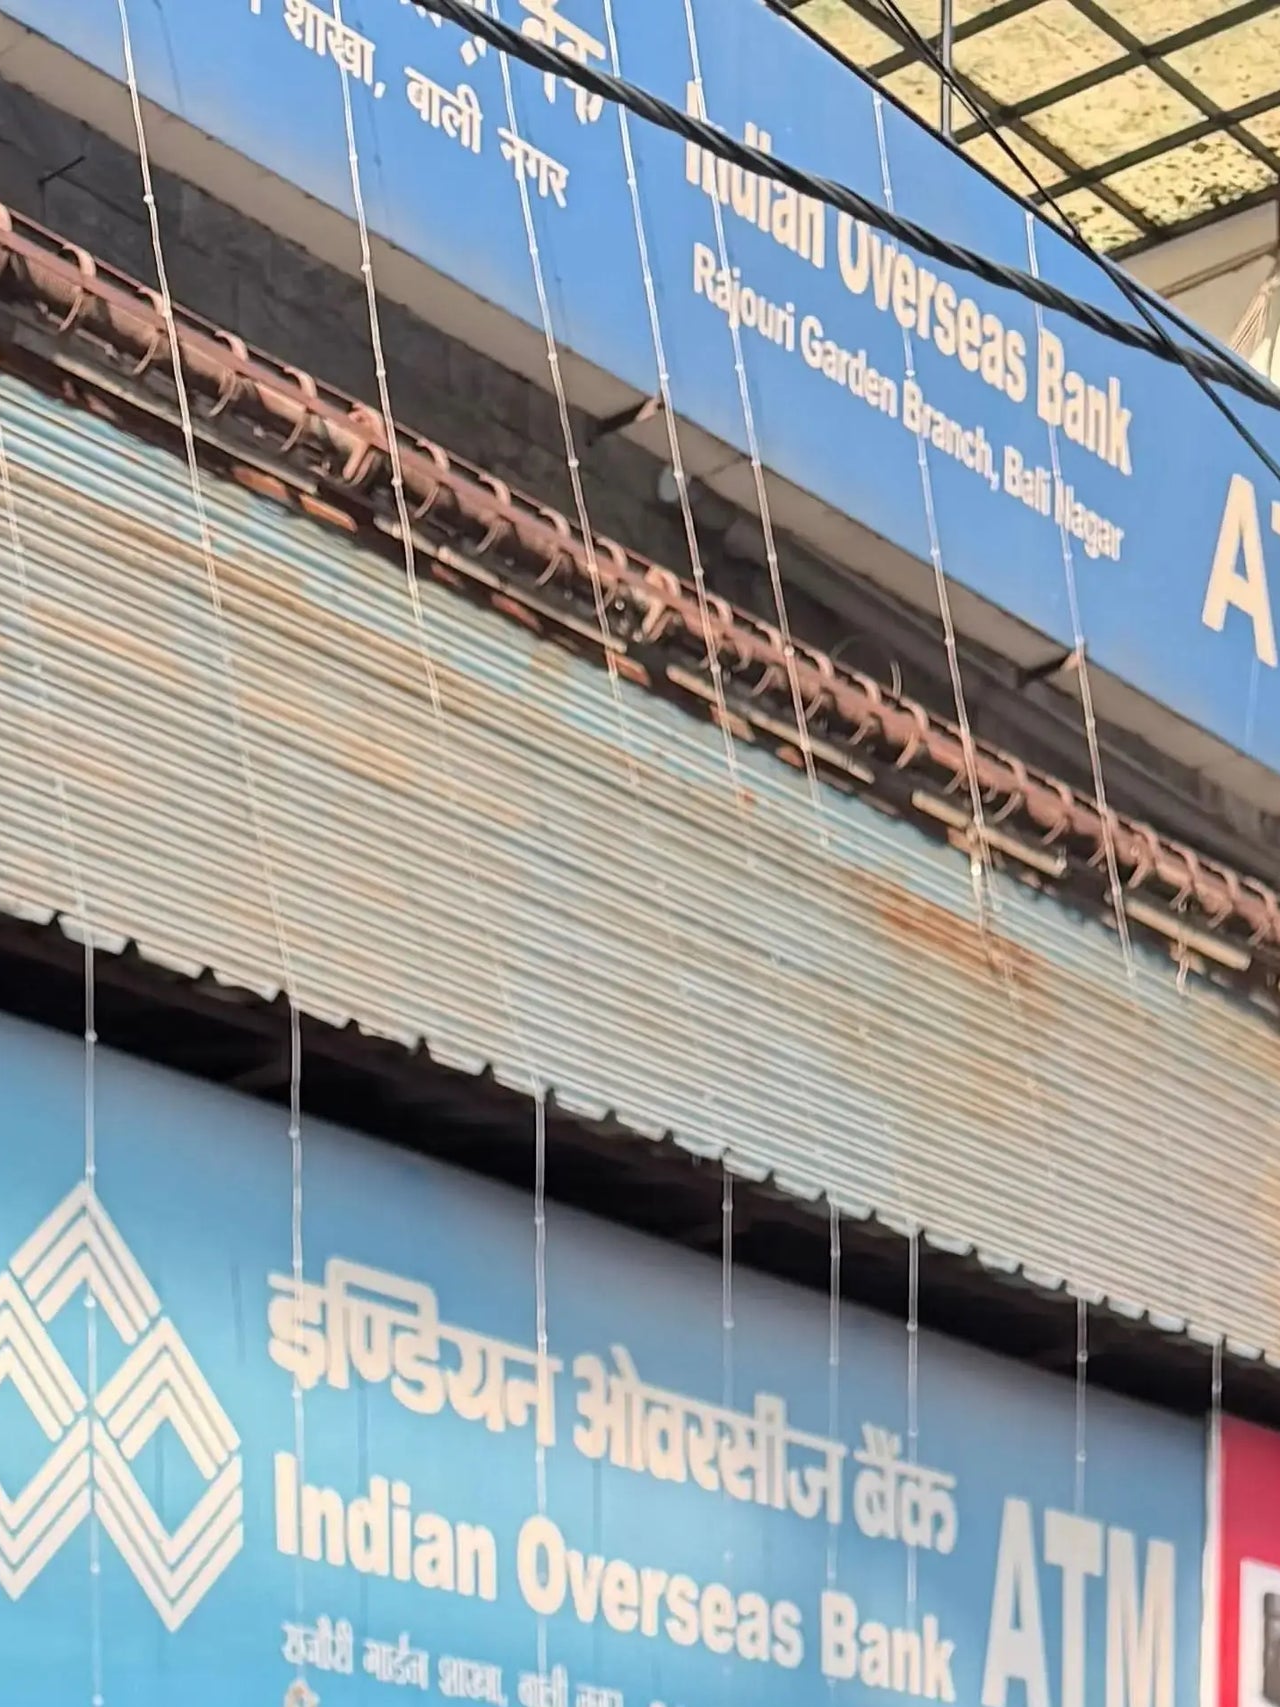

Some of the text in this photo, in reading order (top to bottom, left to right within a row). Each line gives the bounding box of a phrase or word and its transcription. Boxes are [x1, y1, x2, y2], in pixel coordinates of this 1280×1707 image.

[404, 66, 483, 154] बाली
[497, 127, 570, 208] नगर
[693, 242, 1125, 562] Rajouri Garden Branch, Bali Nagar
[837, 208, 1027, 403] Overseas
[1037, 327, 1133, 476] Bank
[273, 1450, 497, 1602] Indian
[516, 1514, 805, 1669] Overseas
[820, 1588, 956, 1703] Bank
